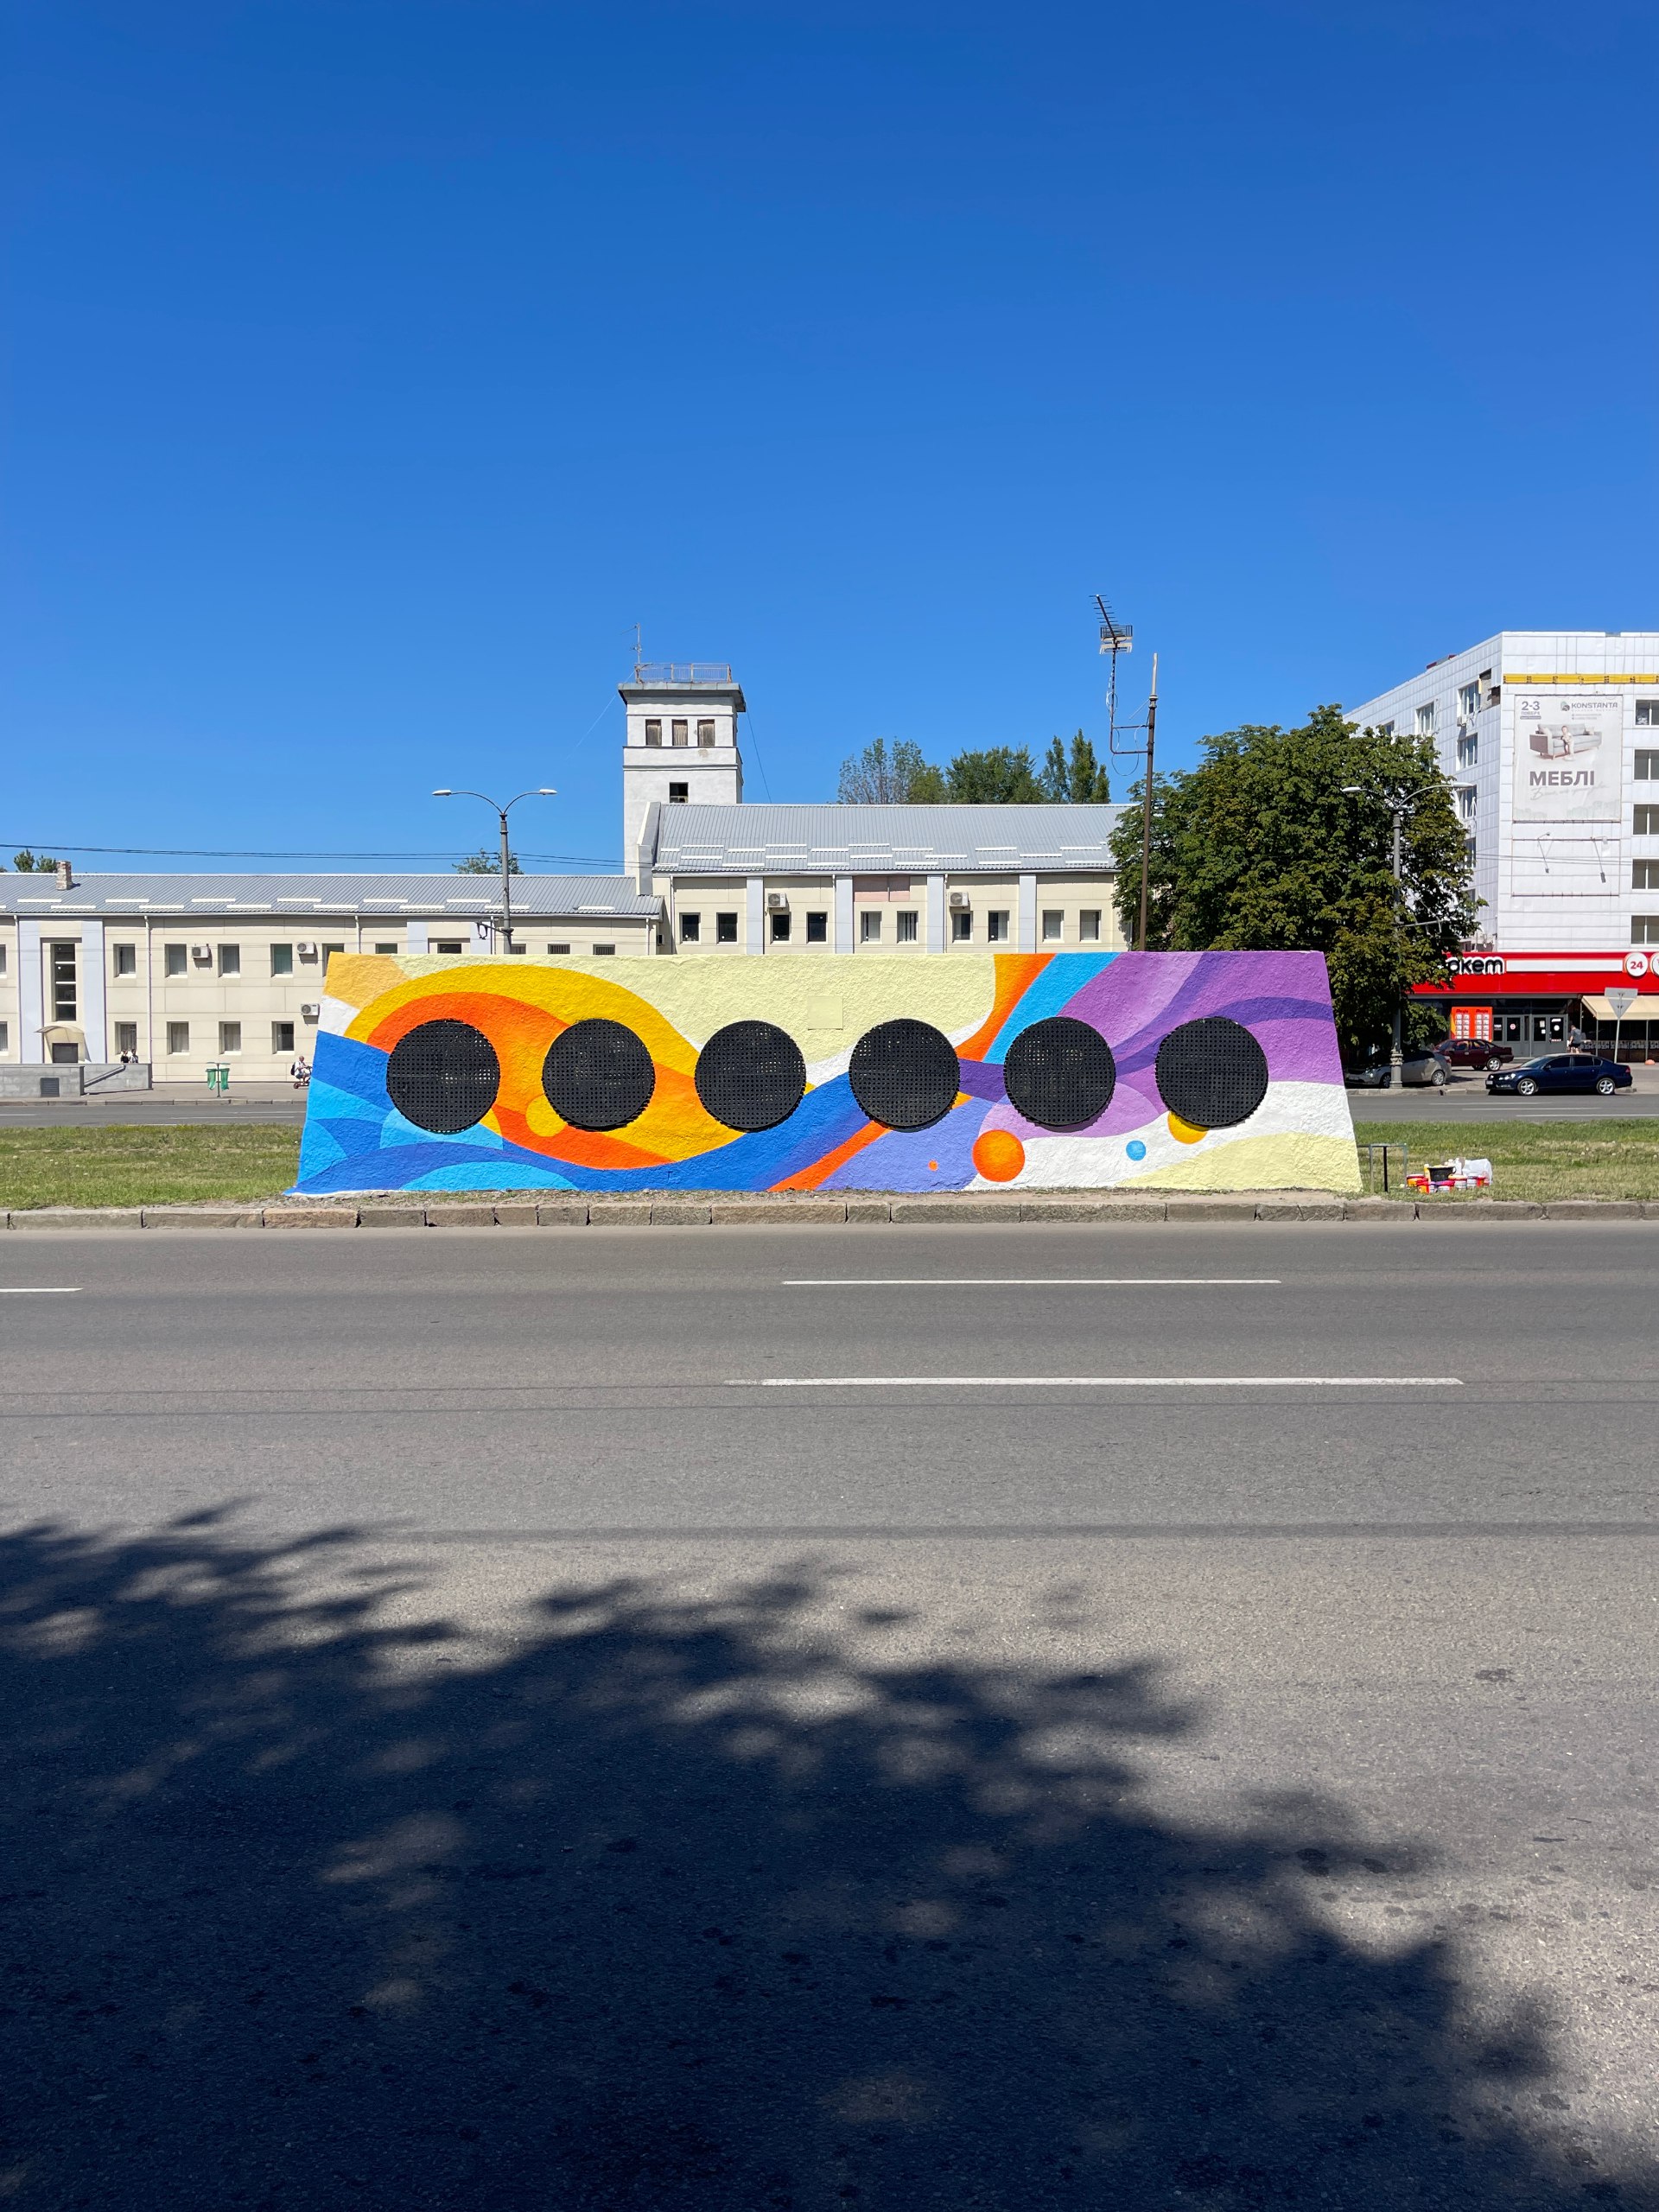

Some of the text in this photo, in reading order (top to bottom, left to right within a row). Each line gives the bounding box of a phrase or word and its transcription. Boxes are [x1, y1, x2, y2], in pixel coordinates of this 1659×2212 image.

[1522, 701, 1540, 710] 2-3
[1529, 771, 1594, 785] МЕБЛІ
[1630, 961, 1643, 969] 24
